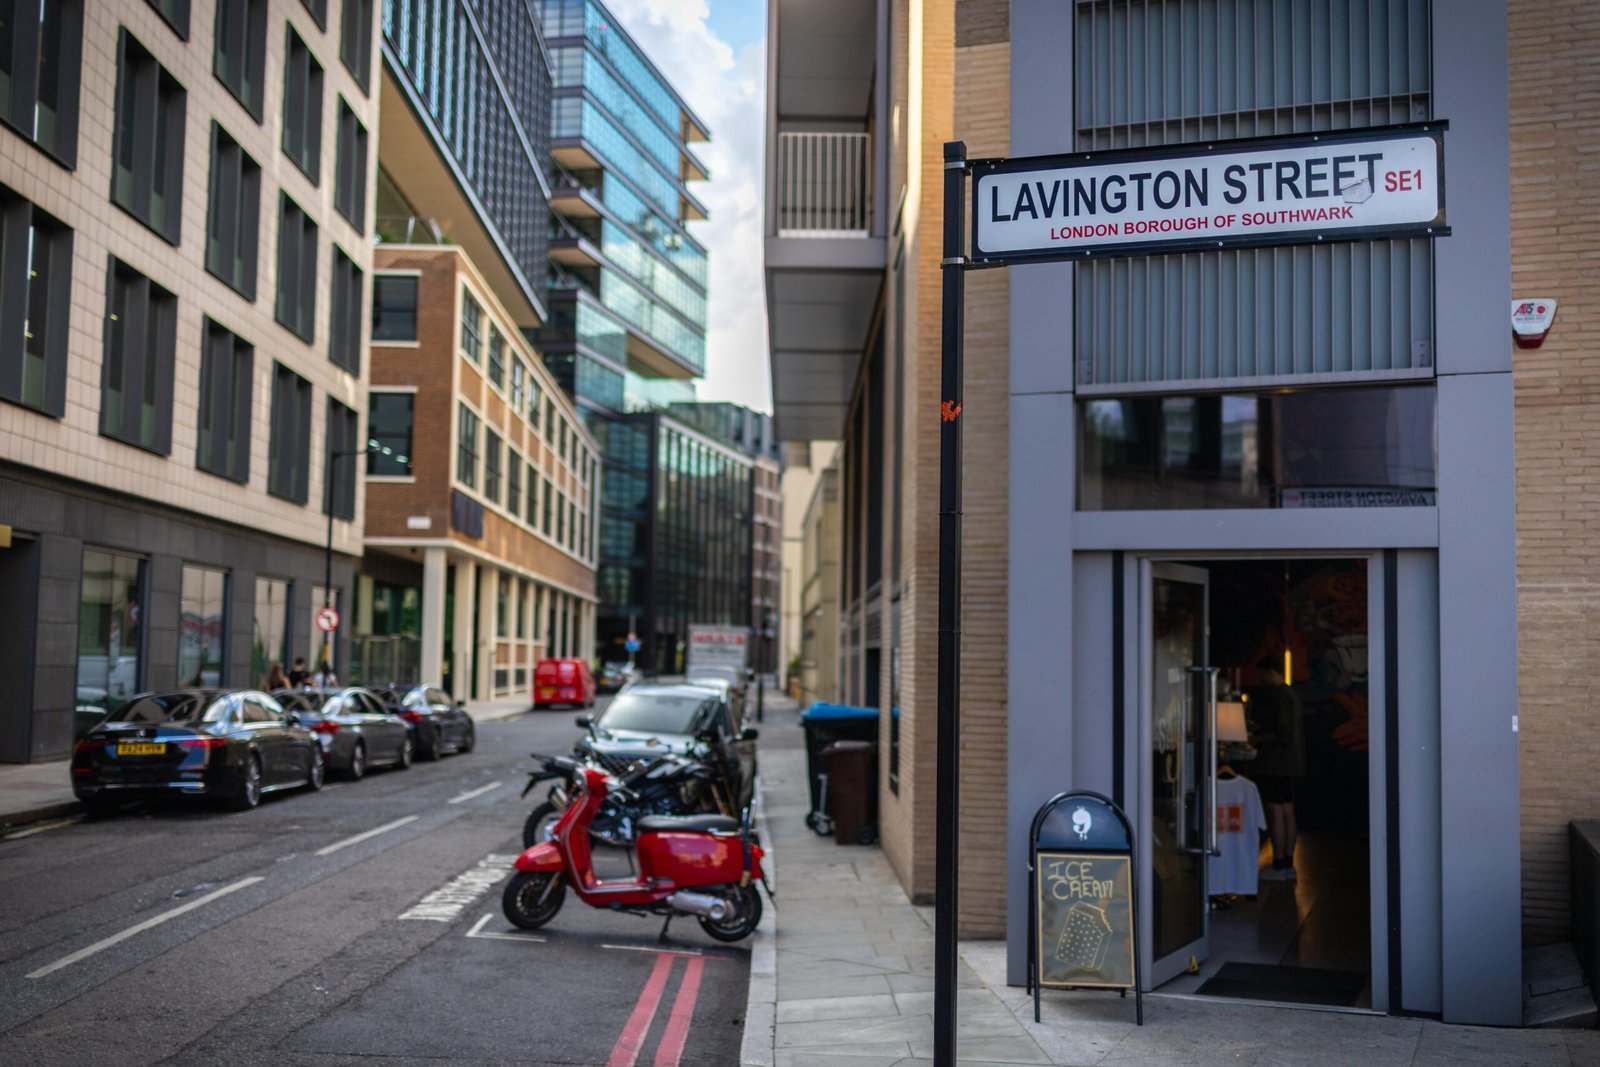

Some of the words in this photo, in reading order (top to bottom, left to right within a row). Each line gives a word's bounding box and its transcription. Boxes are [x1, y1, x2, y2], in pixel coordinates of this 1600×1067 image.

[992, 167, 1208, 222] LAVINGTON
[1223, 153, 1383, 204] STREET
[1385, 169, 1422, 193] SE1
[1051, 223, 1119, 240] LONDON
[1124, 217, 1208, 235] BOROUGH
[1213, 214, 1236, 228] OF
[1241, 206, 1354, 226] SOUTHWARK
[1048, 861, 1094, 880] ICE
[1052, 880, 1114, 900] CREAM
